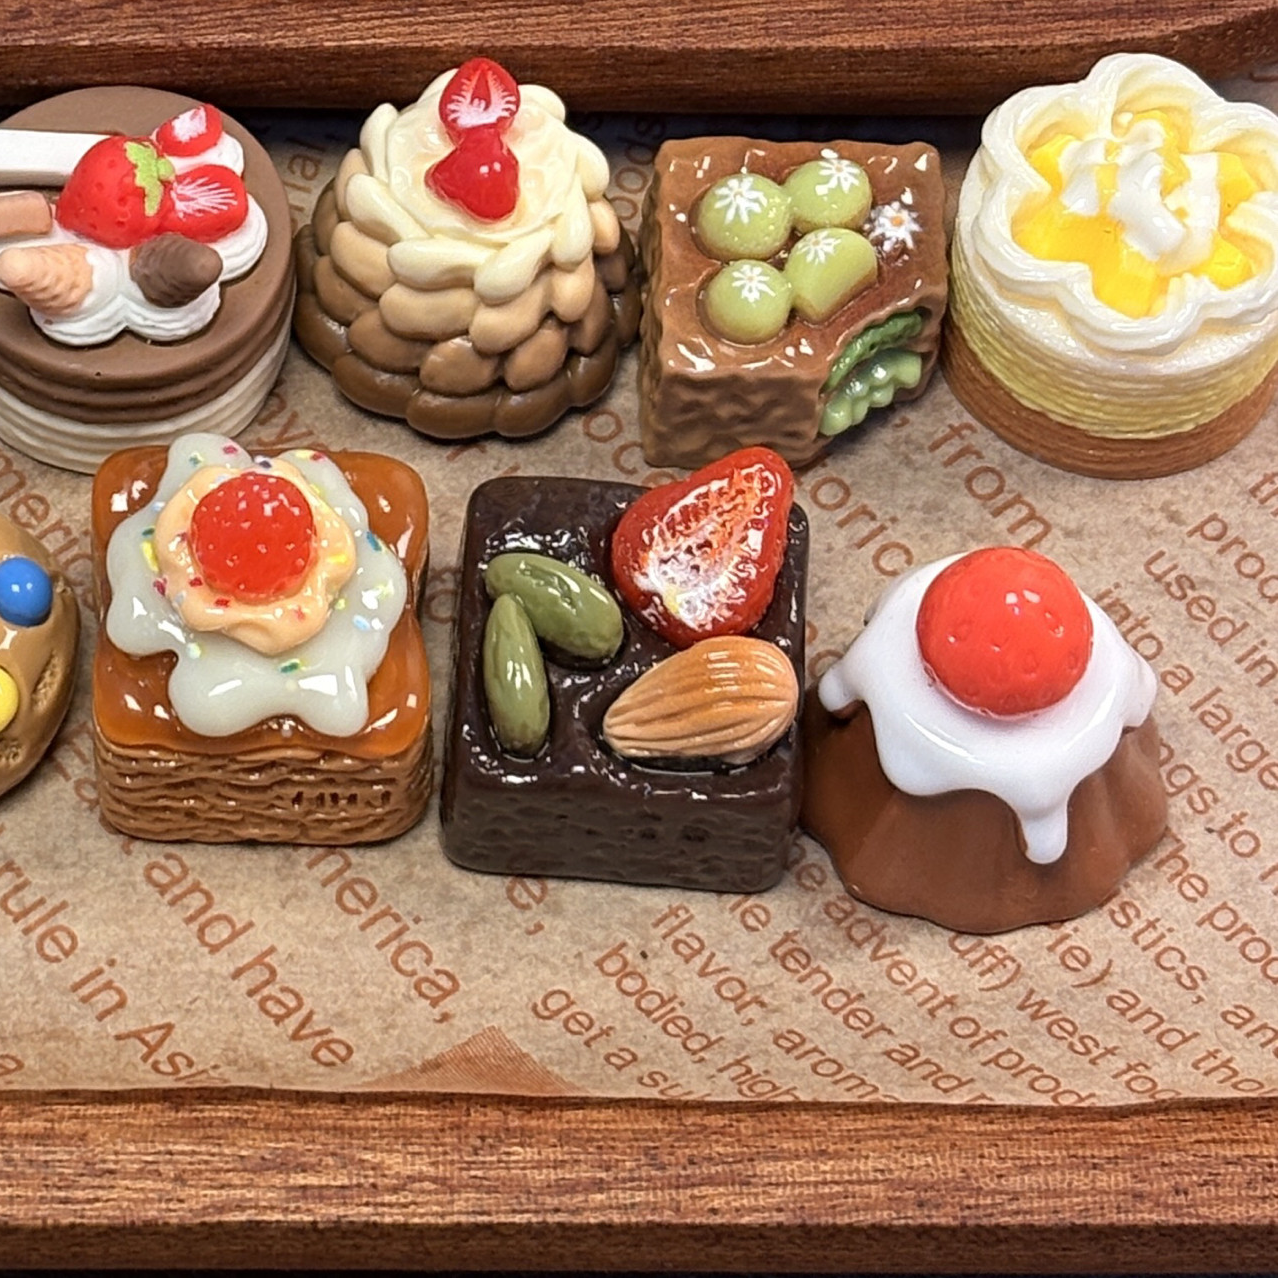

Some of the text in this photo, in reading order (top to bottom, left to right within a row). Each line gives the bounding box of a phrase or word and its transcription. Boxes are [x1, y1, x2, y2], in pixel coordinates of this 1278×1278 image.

[927, 421, 1053, 551] from
[1142, 548, 1250, 648] used
[1159, 663, 1196, 696] a
[1217, 811, 1262, 859] to
[69, 957, 129, 1022] in
[142, 851, 356, 1069] and have
[593, 940, 726, 1065] bodied,
[650, 902, 769, 1028] flavor,
[823, 893, 960, 1020] advent
[948, 1014, 1009, 1050] of
[530, 988, 617, 1049] get
[603, 1046, 640, 1072] a
[768, 928, 897, 1040] tender
[882, 1042, 976, 1094] and
[1016, 987, 1121, 1067] west
[1105, 988, 1201, 1053] and
